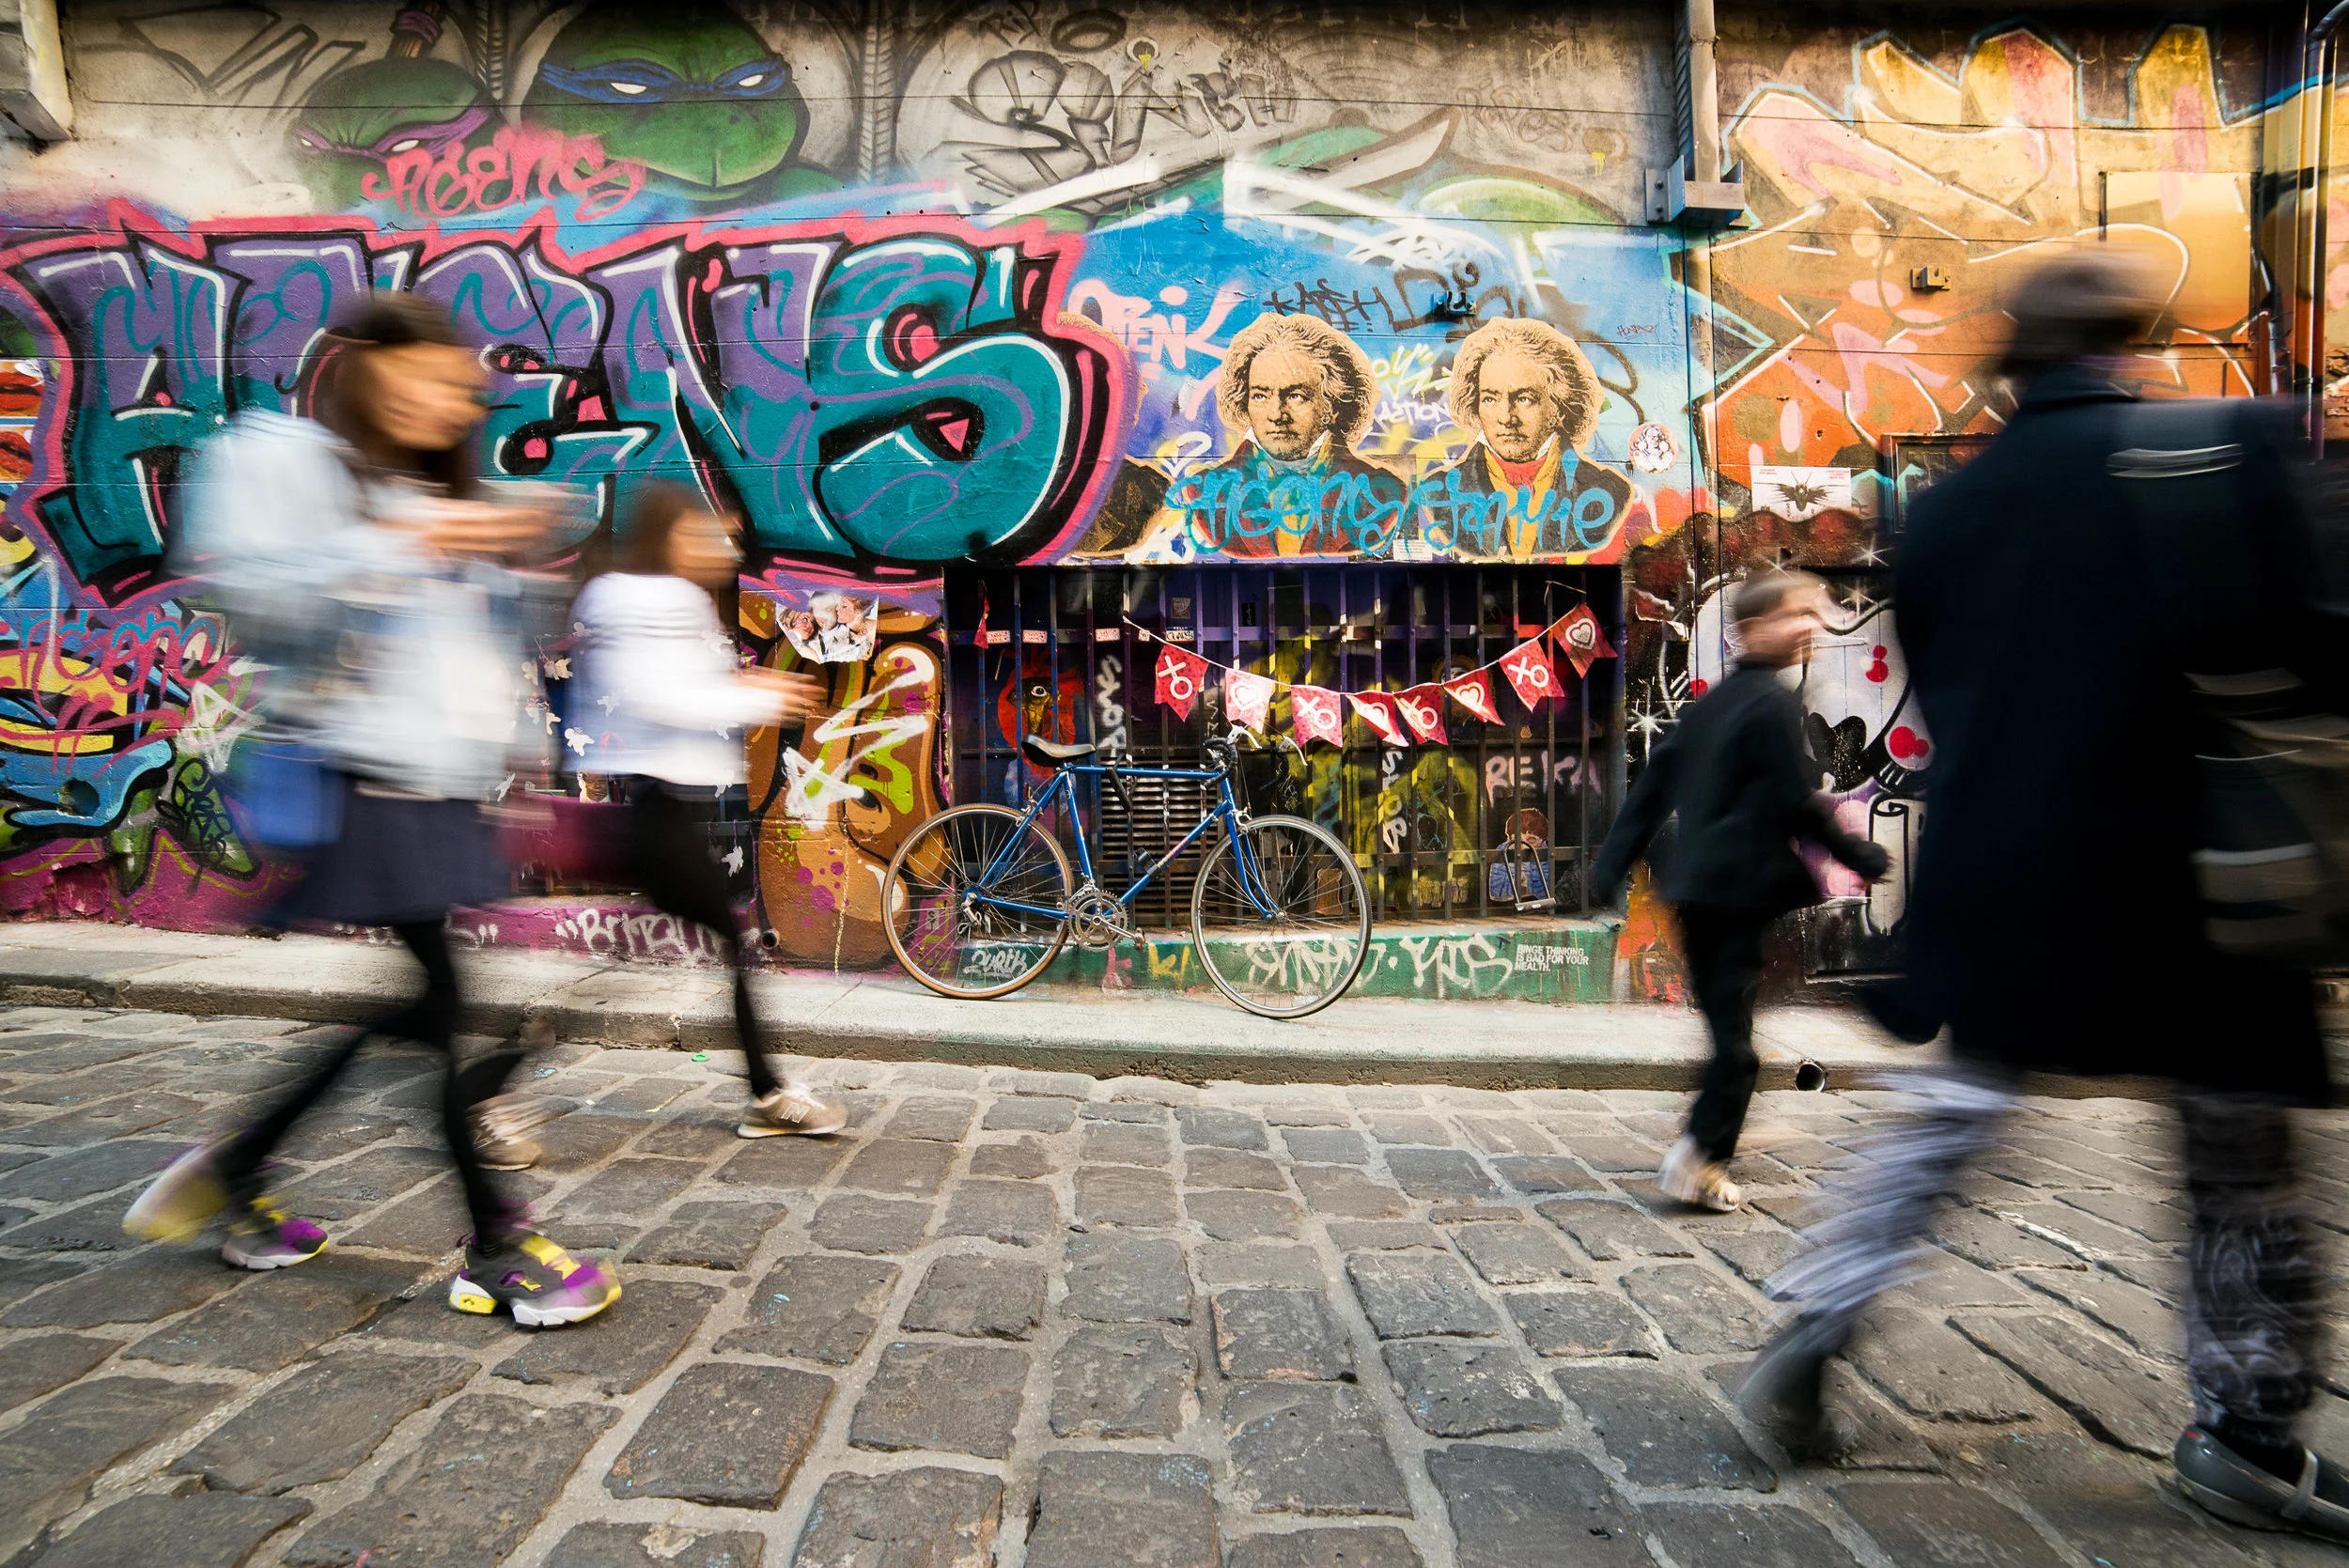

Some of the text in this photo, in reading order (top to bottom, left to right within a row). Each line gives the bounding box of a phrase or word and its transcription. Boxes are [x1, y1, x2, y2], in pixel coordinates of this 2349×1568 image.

[1517, 943, 1585, 956] BINGE THINKING
[1516, 953, 1590, 966] IS BAD FOR YOUR
[1514, 961, 1551, 972] HEALTH.
